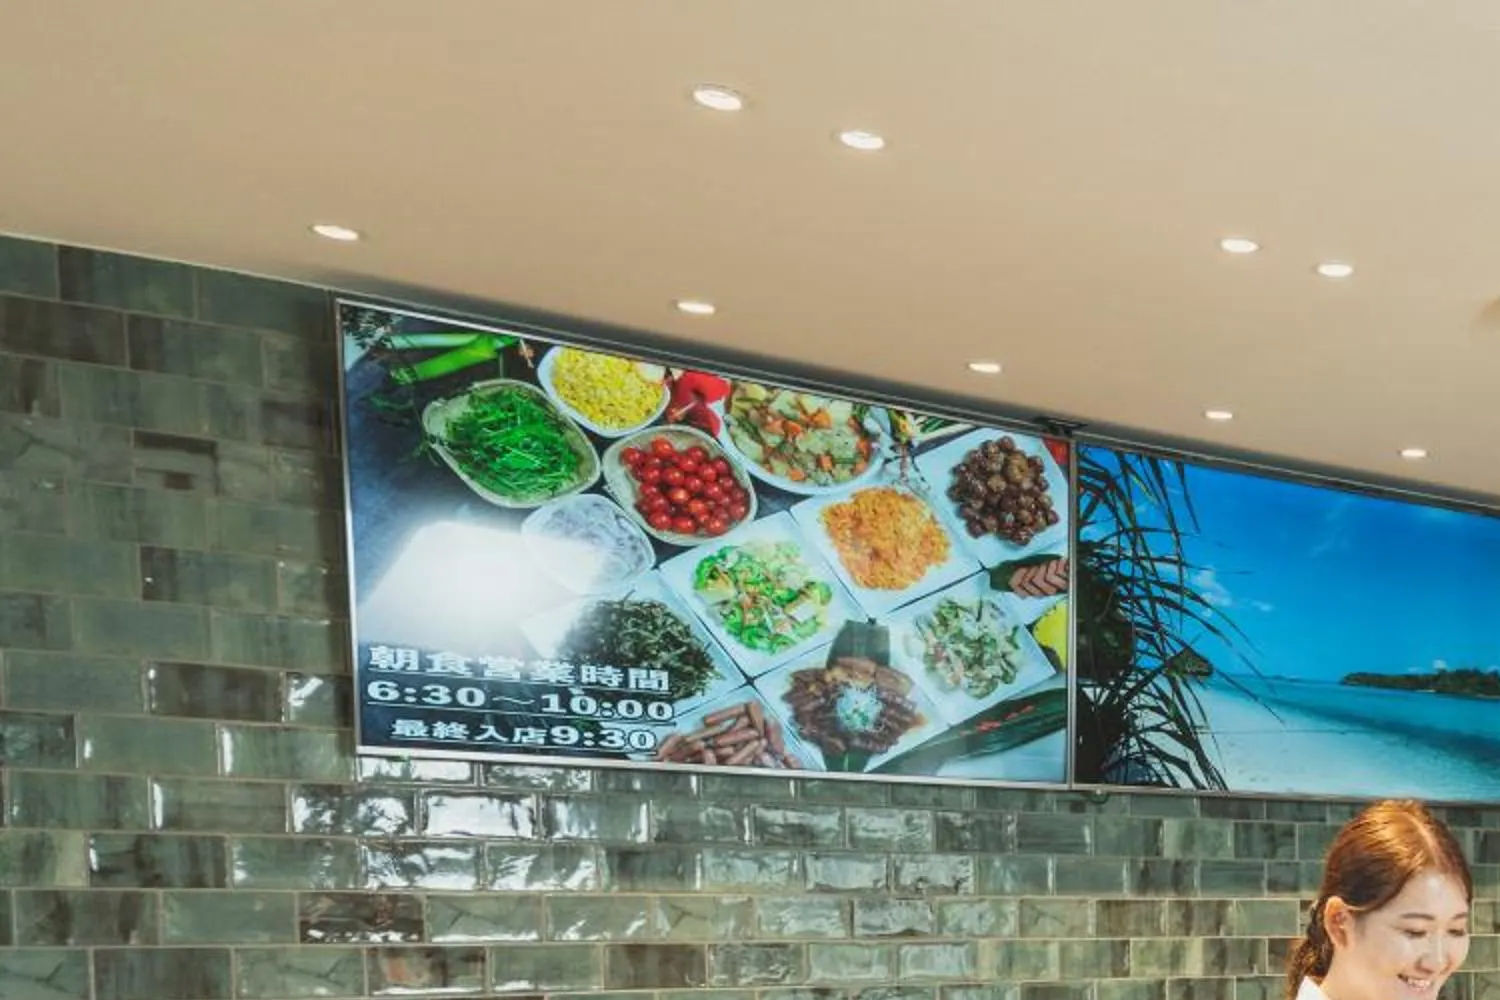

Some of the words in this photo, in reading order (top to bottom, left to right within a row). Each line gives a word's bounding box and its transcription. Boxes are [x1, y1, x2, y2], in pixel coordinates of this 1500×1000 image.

[369, 646, 669, 690] 朝食営業時間
[392, 720, 655, 750] 最終入店9:30
